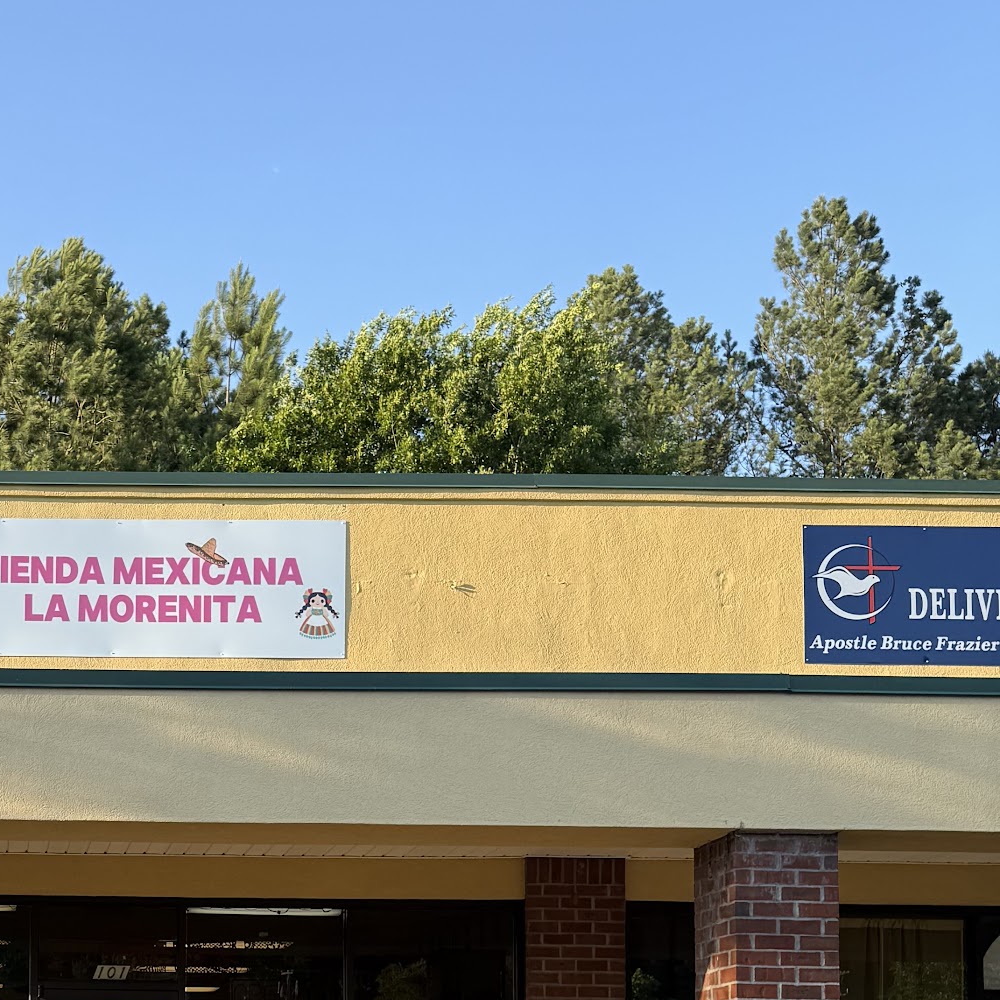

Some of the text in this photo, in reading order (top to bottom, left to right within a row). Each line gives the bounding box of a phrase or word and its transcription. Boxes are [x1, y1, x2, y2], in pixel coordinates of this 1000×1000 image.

[112, 556, 304, 586] MEXICANA
[23, 594, 263, 624] LA MORENITA
[908, 588, 1000, 620] DELIV
[809, 635, 1000, 653] Apostle Bruce Frazier
[98, 966, 125, 979] 101
